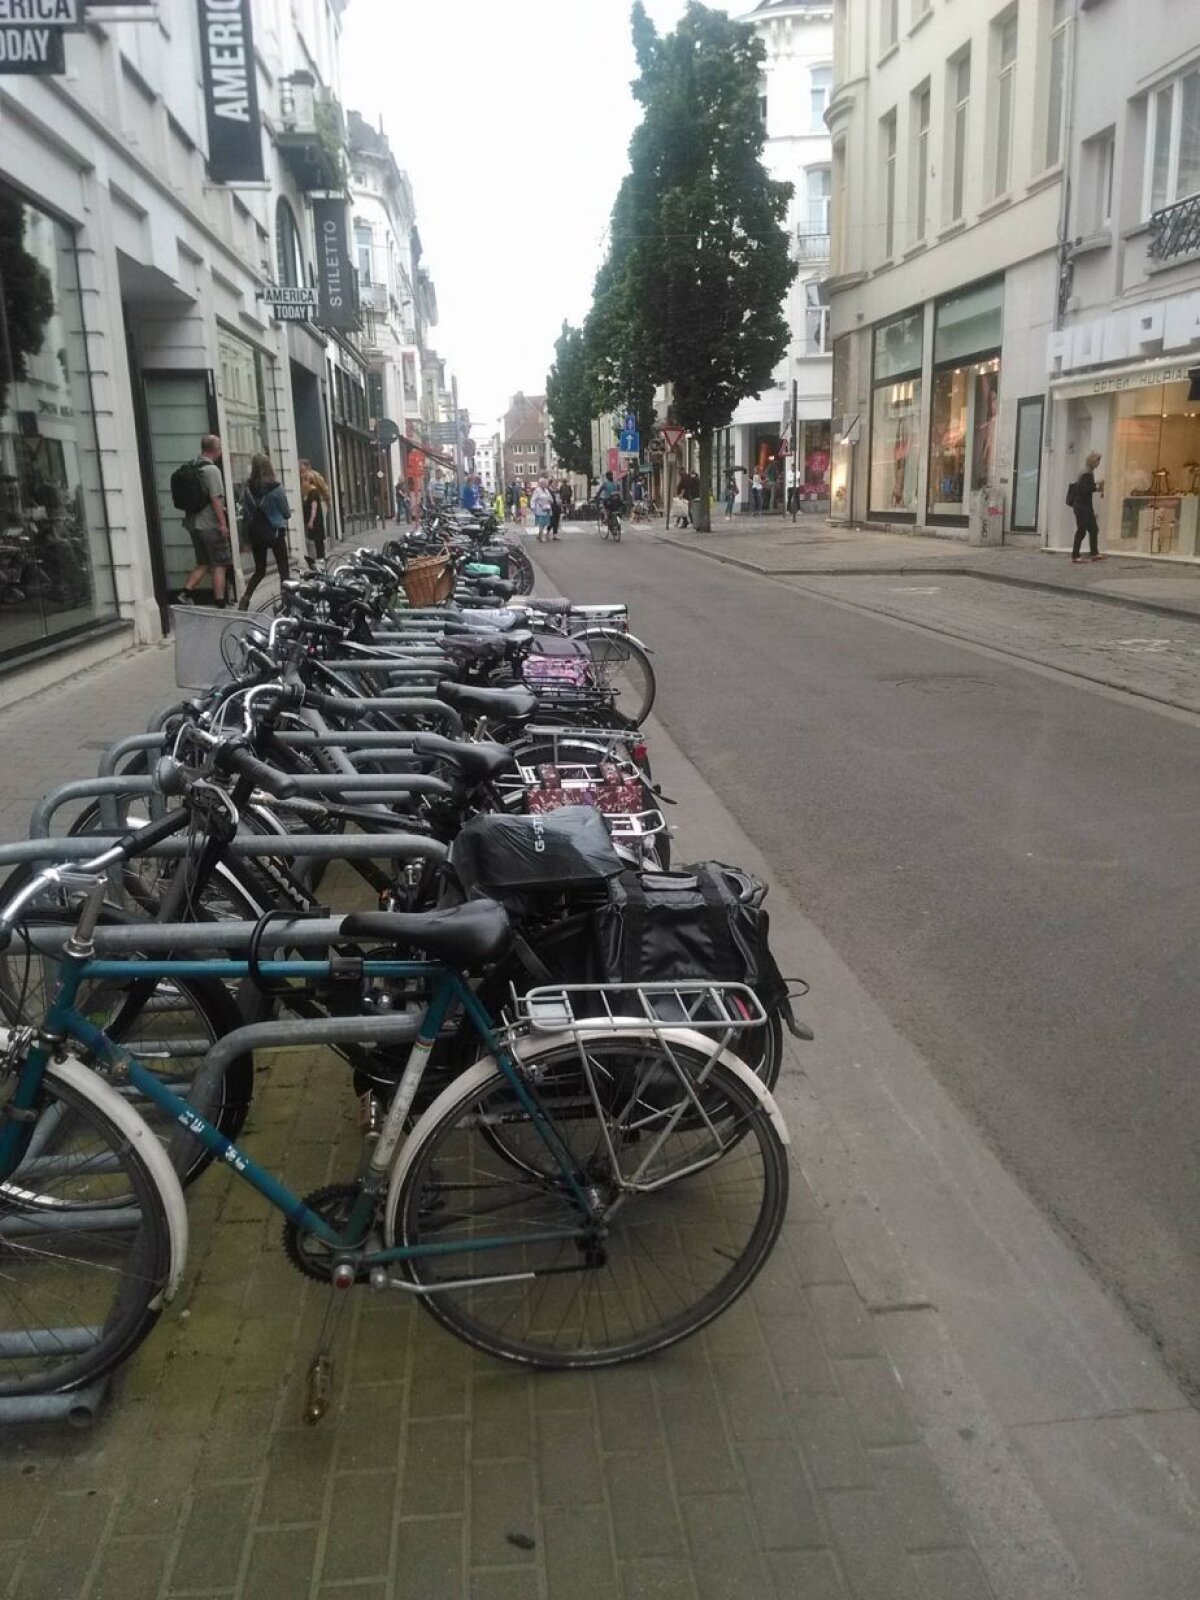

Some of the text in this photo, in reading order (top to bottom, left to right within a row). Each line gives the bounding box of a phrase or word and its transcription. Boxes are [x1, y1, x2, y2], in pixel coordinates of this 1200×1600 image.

[323, 220, 342, 307] STILETTO
[265, 289, 315, 303] AMERICA
[276, 305, 306, 319] TODAY
